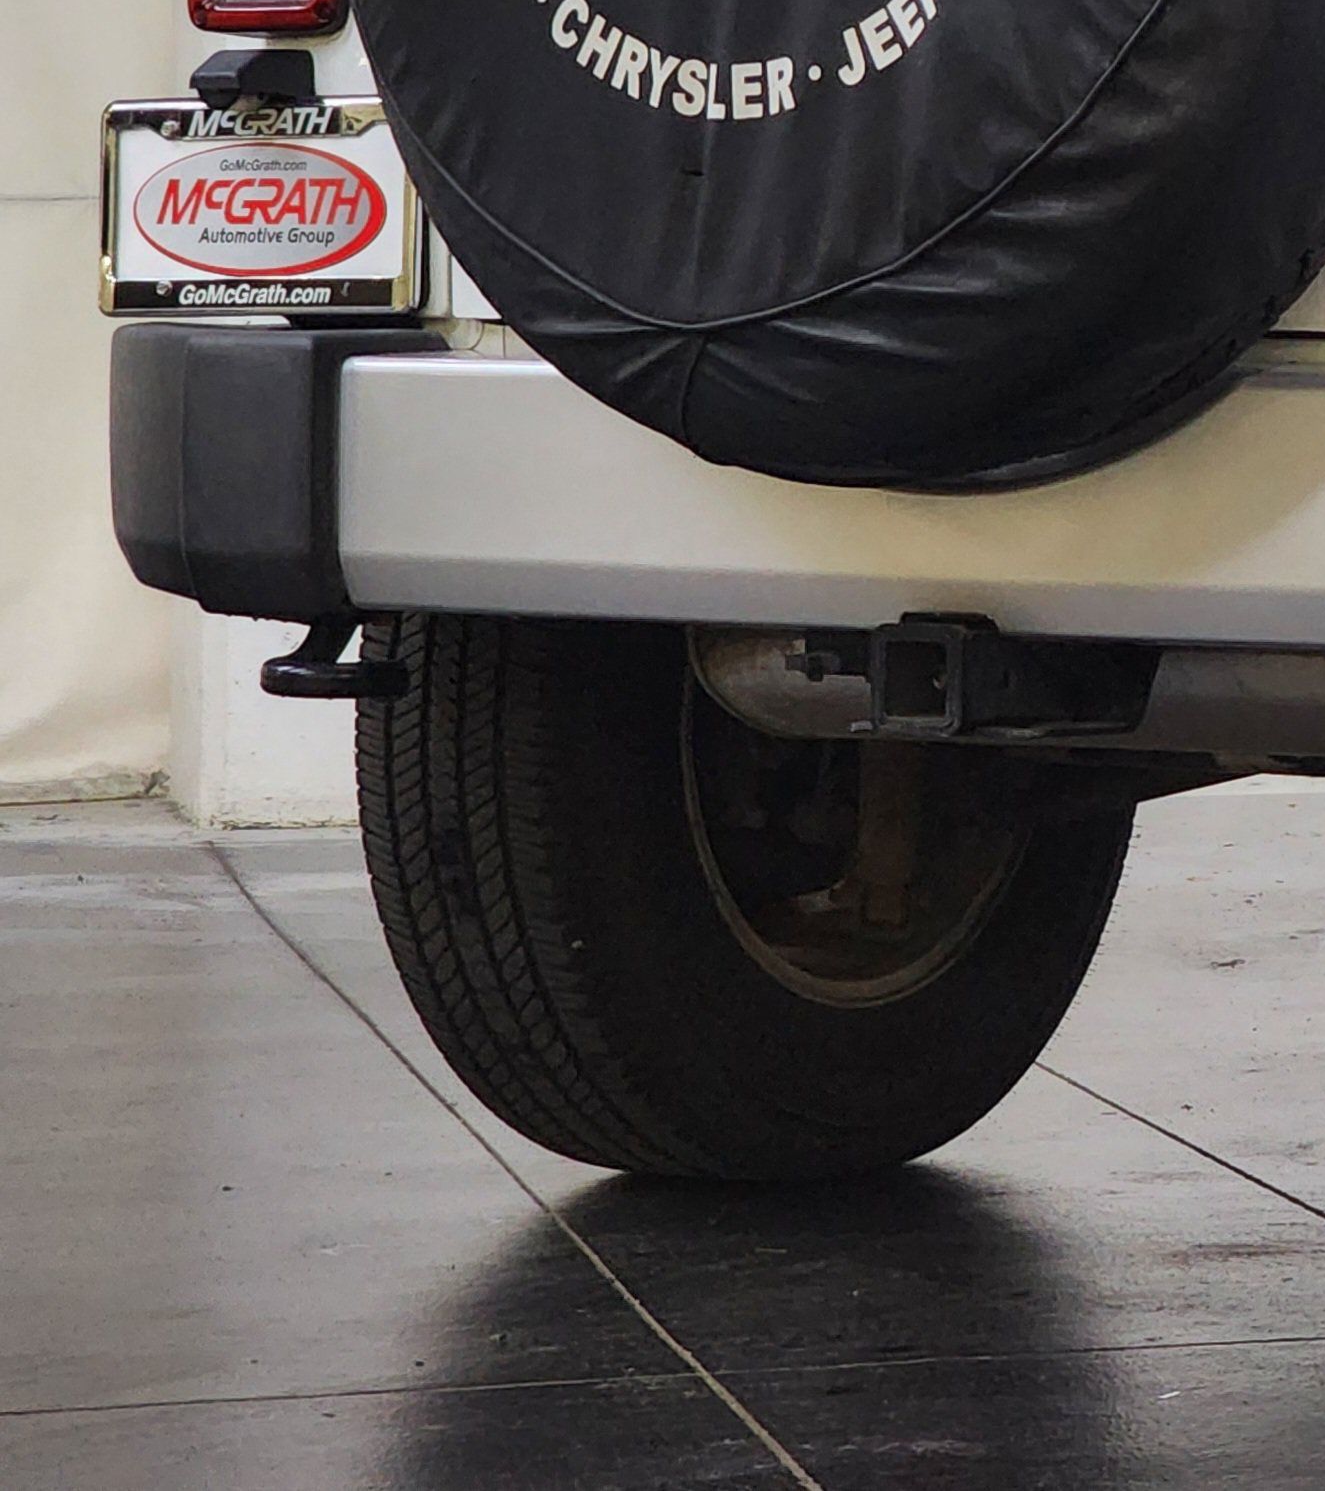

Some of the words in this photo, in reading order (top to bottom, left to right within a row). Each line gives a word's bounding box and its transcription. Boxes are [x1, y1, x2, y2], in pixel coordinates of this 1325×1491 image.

[219, 159, 308, 173] GoMcGrath.com
[198, 227, 283, 244] Automotive
[287, 227, 336, 248] Group
[178, 282, 332, 306] GoMcGrath.com
